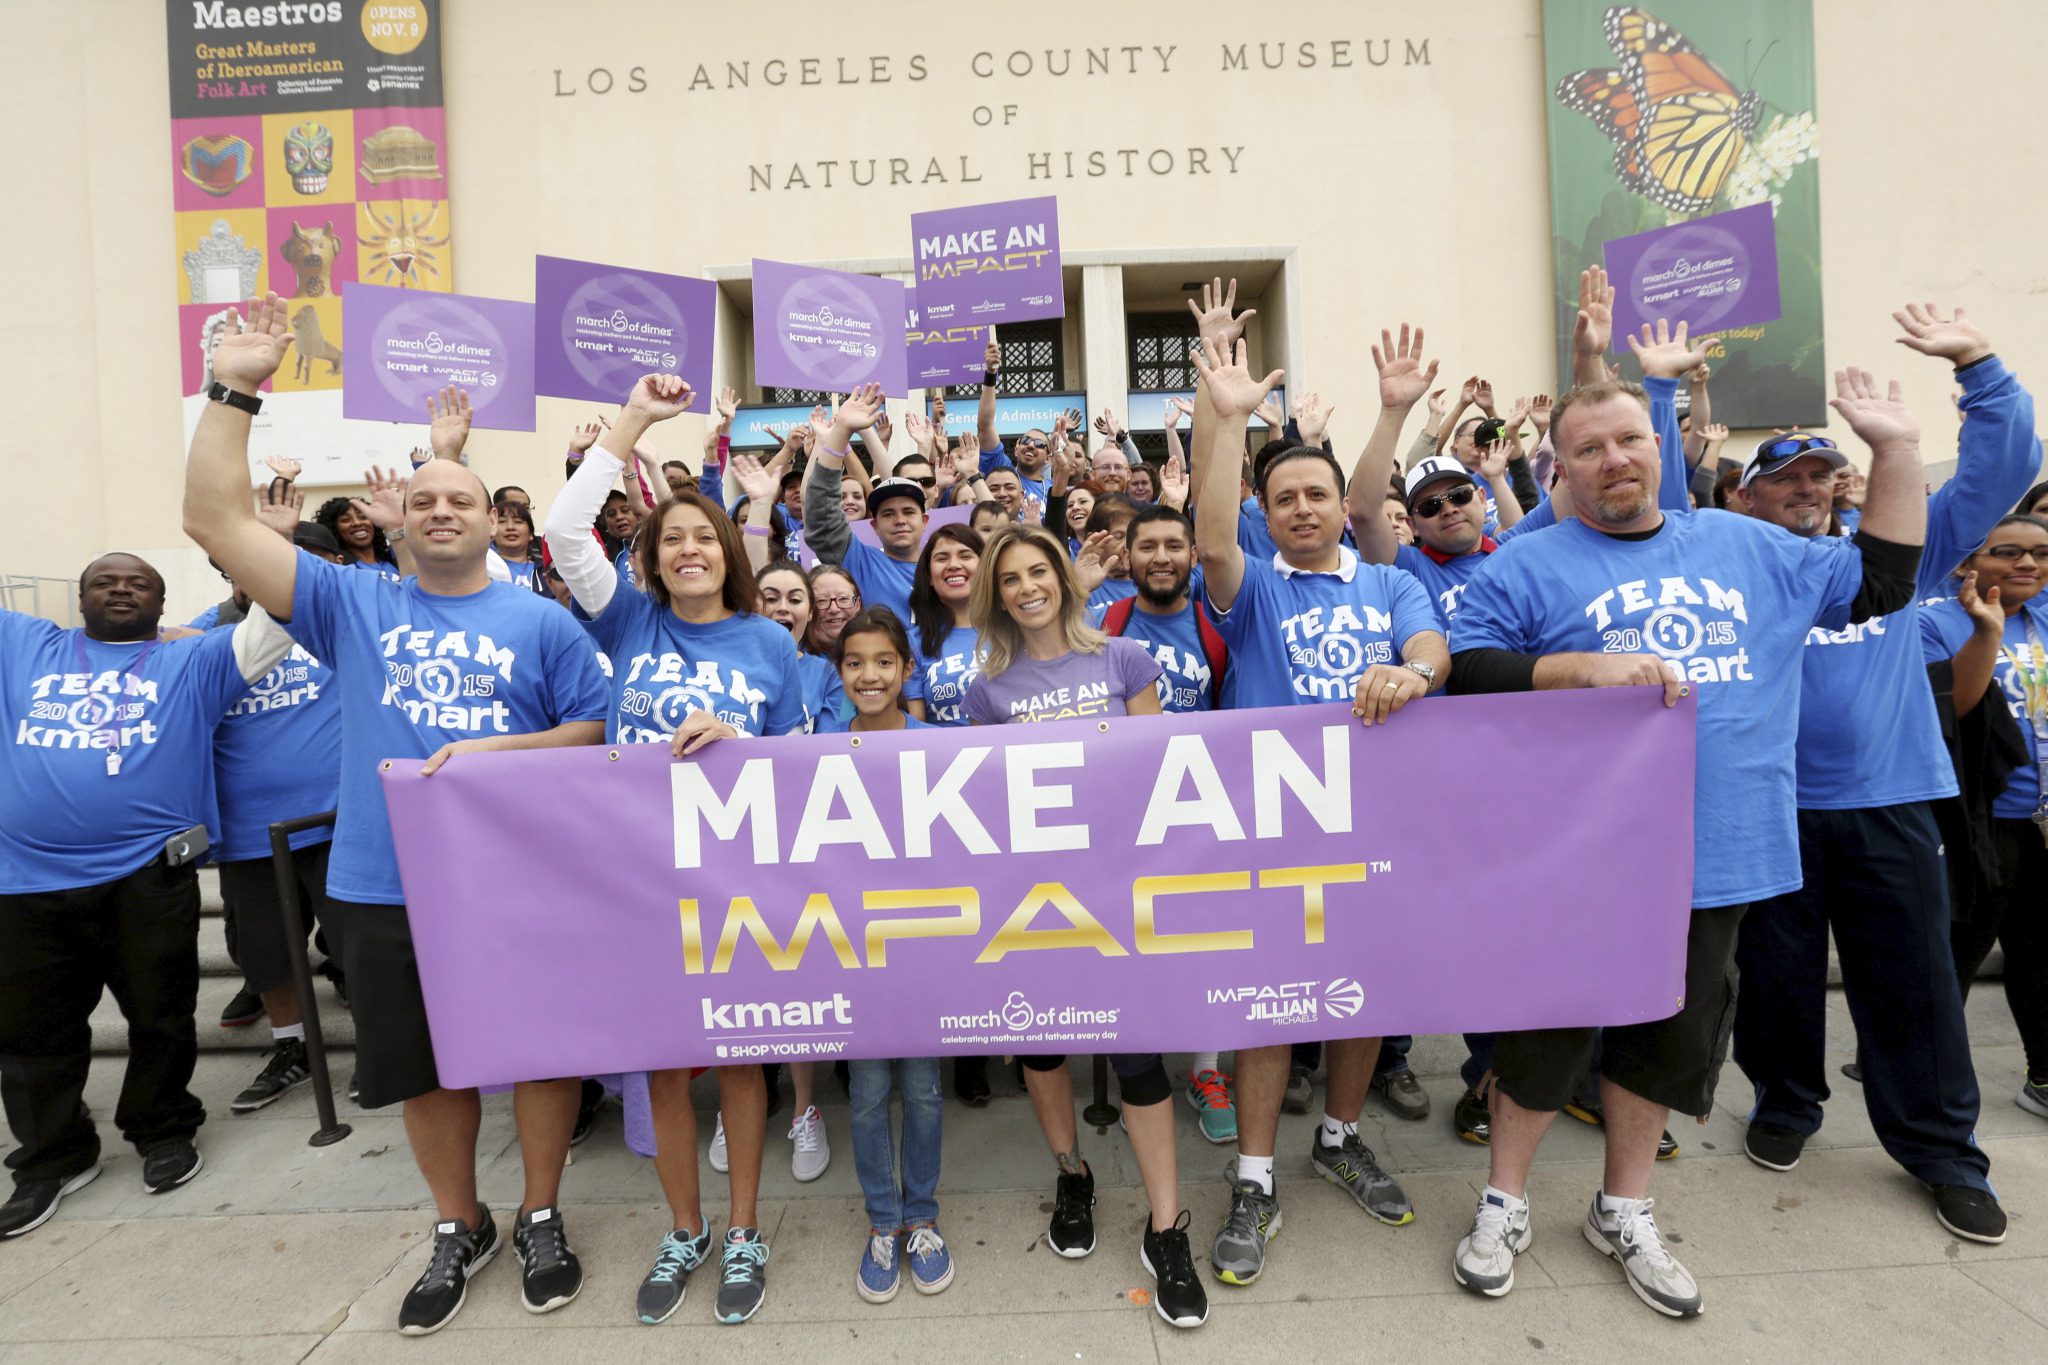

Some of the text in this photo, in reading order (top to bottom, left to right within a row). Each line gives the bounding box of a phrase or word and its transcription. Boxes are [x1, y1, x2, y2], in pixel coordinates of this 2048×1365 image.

[193, 1, 342, 29] Maestros
[370, 6, 416, 20] OPENS
[371, 22, 419, 37] NOV. 9
[196, 40, 316, 60] Great Masters
[196, 59, 344, 79] of Iberoamerican
[553, 38, 1431, 96] LOS ANGELES COUNTY MUSEUM
[197, 80, 268, 98] Folk Art
[972, 104, 1019, 126] OF
[749, 146, 1245, 191] NATURAL HISTORY
[920, 223, 1046, 260] MAKE AN
[922, 250, 1049, 281] IMPACT
[1643, 270, 1674, 285] march
[1702, 256, 1734, 271] dimes
[1643, 288, 1679, 305] kmart
[927, 304, 955, 314] kmart
[576, 316, 672, 337] march of dimes
[789, 312, 870, 329] march of dimes
[789, 333, 822, 345] kmart
[905, 326, 984, 347] PACT
[1728, 326, 1765, 342] today!
[387, 338, 490, 356] march of dimes
[576, 339, 614, 352] kmart
[618, 346, 660, 357] IMPACT
[387, 361, 428, 373] kmart
[632, 355, 660, 365] JILLIAN
[433, 367, 479, 376] IMPACT
[448, 375, 478, 383] JILLIAN
[1585, 576, 1748, 632] TEAM
[1281, 605, 1394, 644] TEAM
[1603, 621, 1737, 654] 20 15
[380, 624, 516, 684] TEAM
[1290, 640, 1392, 666] 20 15
[285, 666, 308, 684] 15
[463, 674, 495, 697] 15
[31, 671, 158, 704] TEAM
[624, 652, 766, 725] TEAM
[932, 682, 956, 701] 20
[1011, 681, 1109, 715] MAKE AN
[1174, 687, 1198, 707] 15
[29, 701, 144, 721] 20 15
[620, 688, 653, 717] 20
[16, 720, 157, 749] kmart
[670, 725, 1353, 869] MAKE AN
[679, 862, 1367, 975] IMPACT
[1207, 981, 1317, 1004] IMPACT
[701, 992, 853, 1030] kmart
[939, 1007, 1117, 1030] march of dimes
[1245, 997, 1317, 1021] JILLIAN
[1272, 1014, 1318, 1026] MICHAELS
[941, 1030, 1118, 1046] celebrating mothers and fathers every day
[730, 1041, 845, 1057] SHOP YOUR WAY
